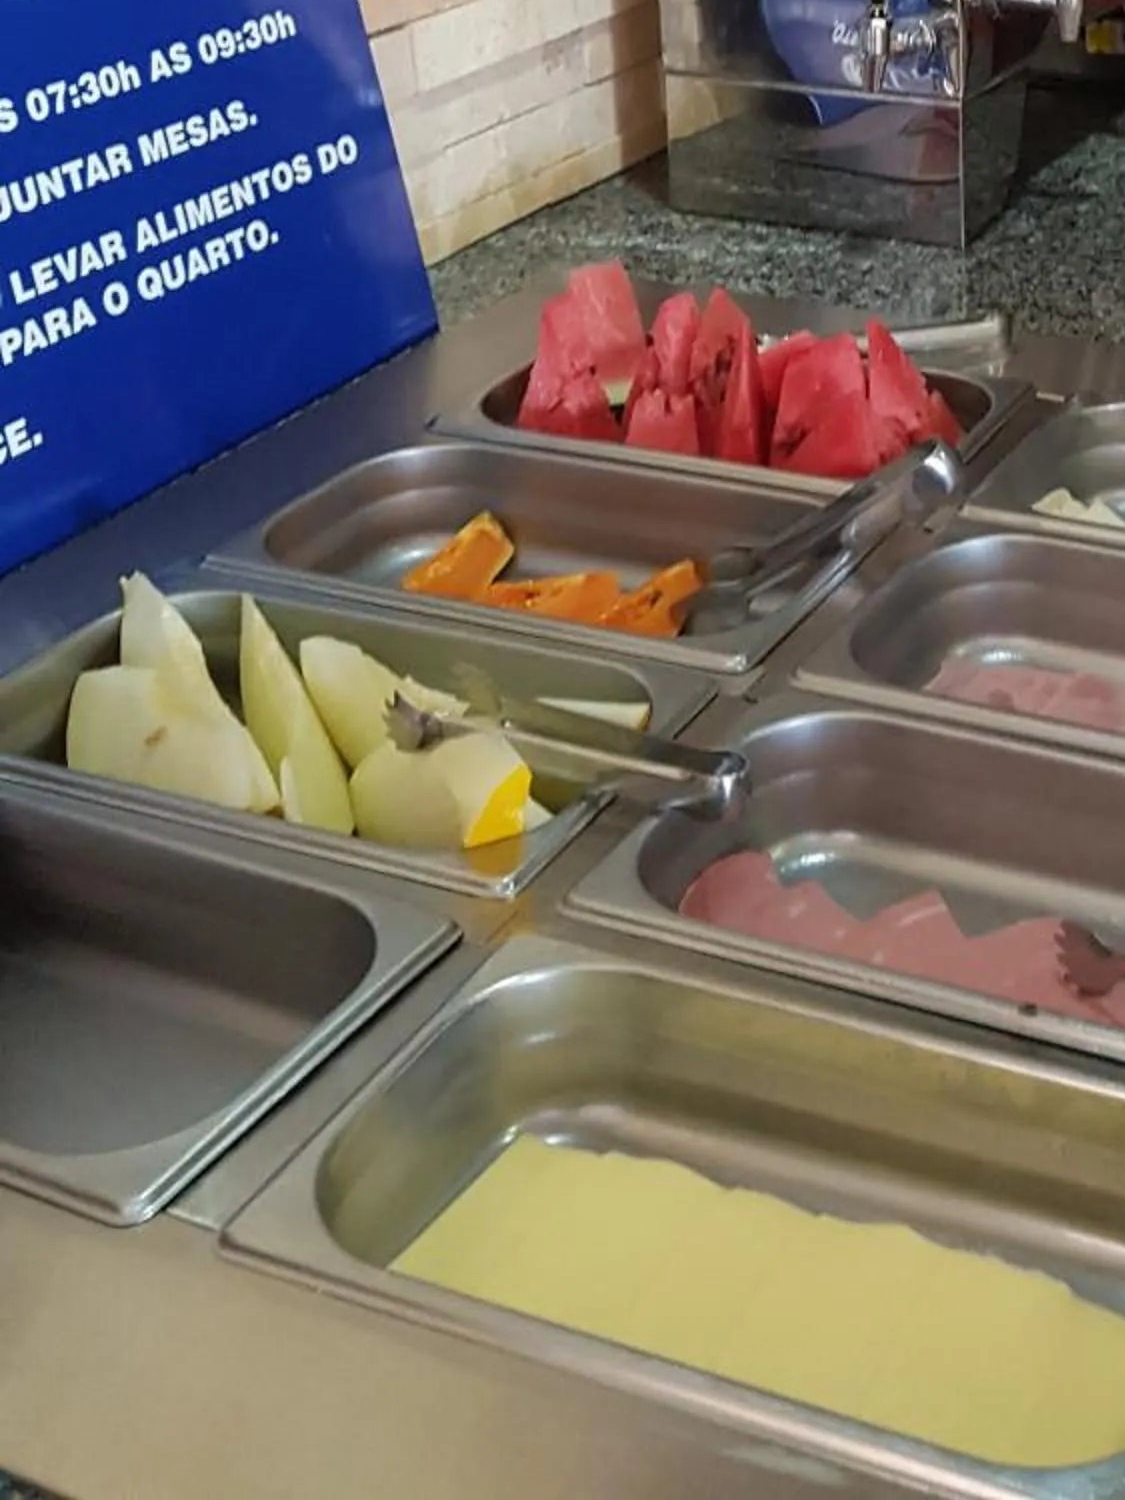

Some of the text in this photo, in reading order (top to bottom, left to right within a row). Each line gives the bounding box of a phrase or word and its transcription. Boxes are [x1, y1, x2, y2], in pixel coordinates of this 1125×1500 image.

[25, 60, 142, 122] 07:30h
[150, 41, 193, 83] AS
[197, 9, 297, 65] 09:30h
[137, 100, 258, 167] MESAS.
[9, 134, 358, 305] LEVAR ALIMENTOS DO
[0, 220, 279, 366] PARA O QUARTO.
